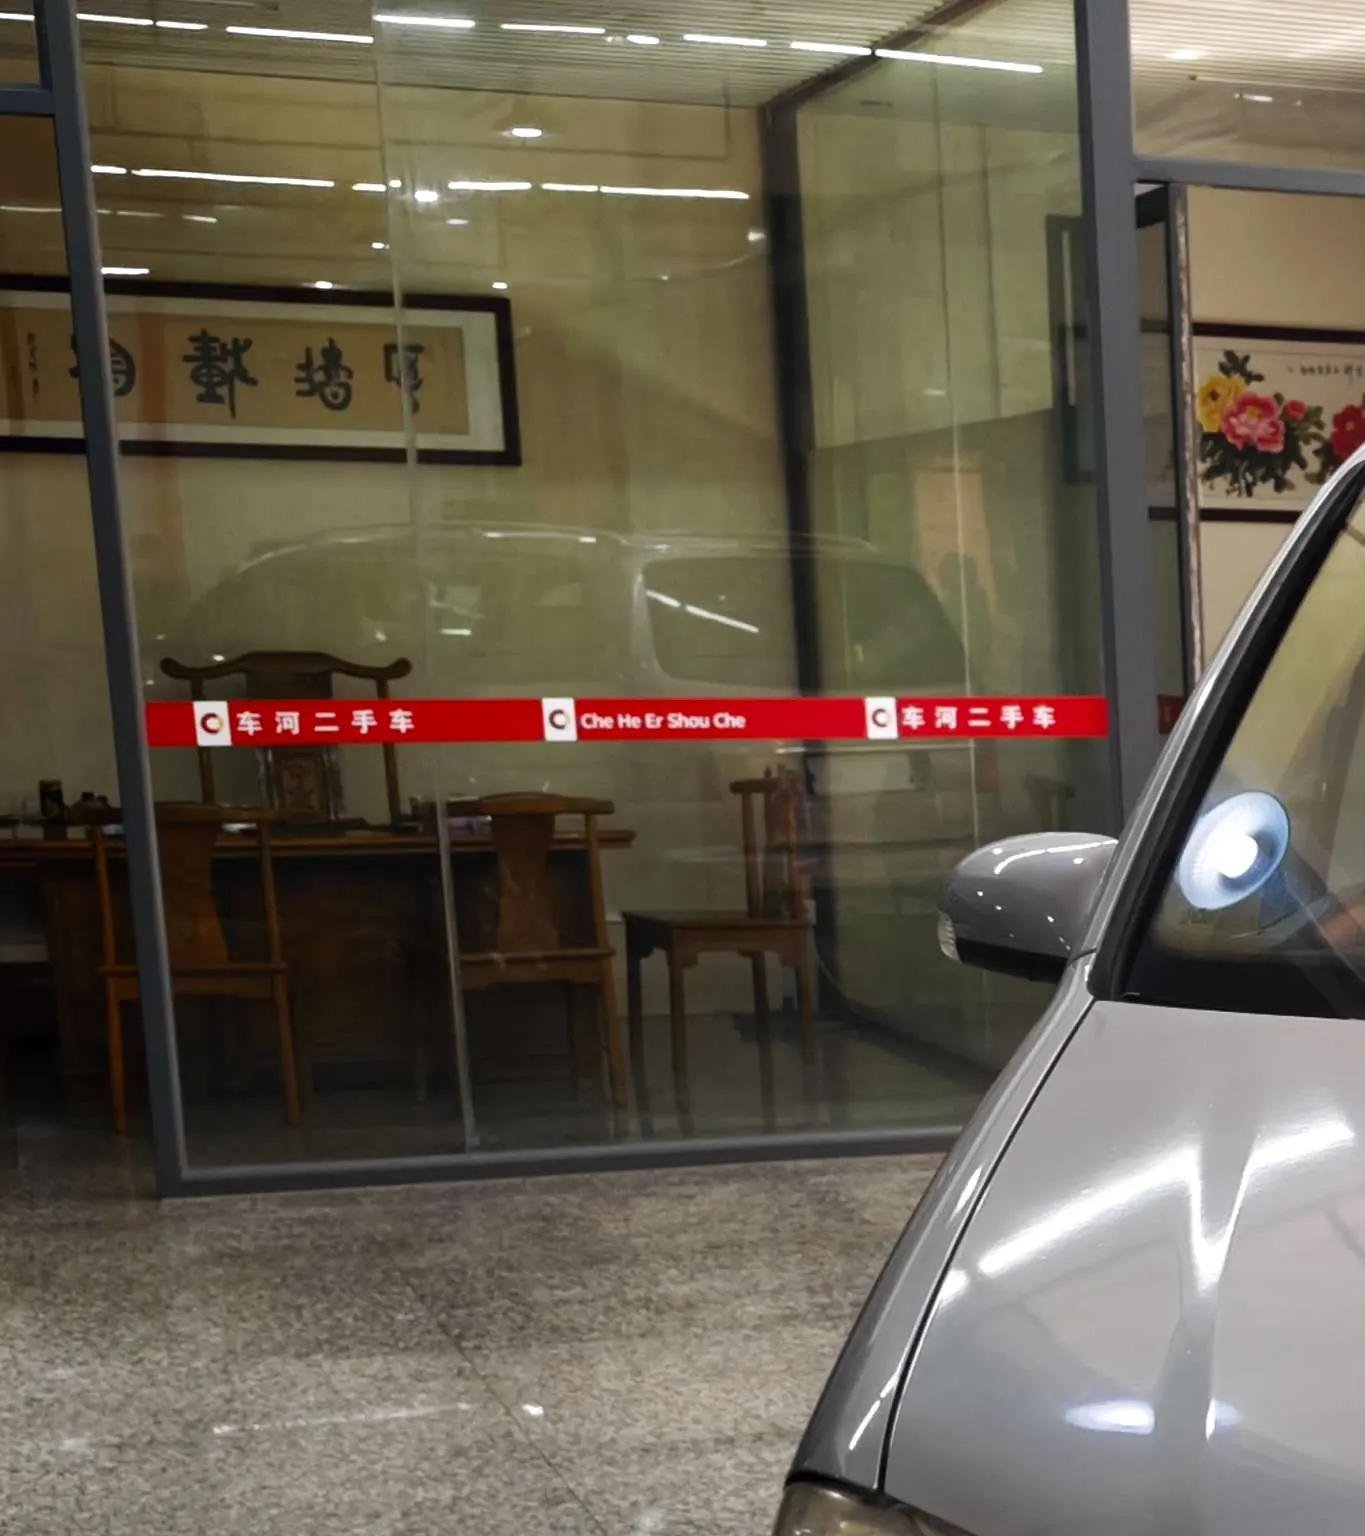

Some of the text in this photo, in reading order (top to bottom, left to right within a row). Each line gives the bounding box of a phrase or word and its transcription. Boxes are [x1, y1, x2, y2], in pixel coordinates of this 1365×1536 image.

[236, 708, 415, 736] 车河二手车
[580, 711, 747, 729] Che He Er Shou Che
[901, 705, 1056, 730] 车河二手车
